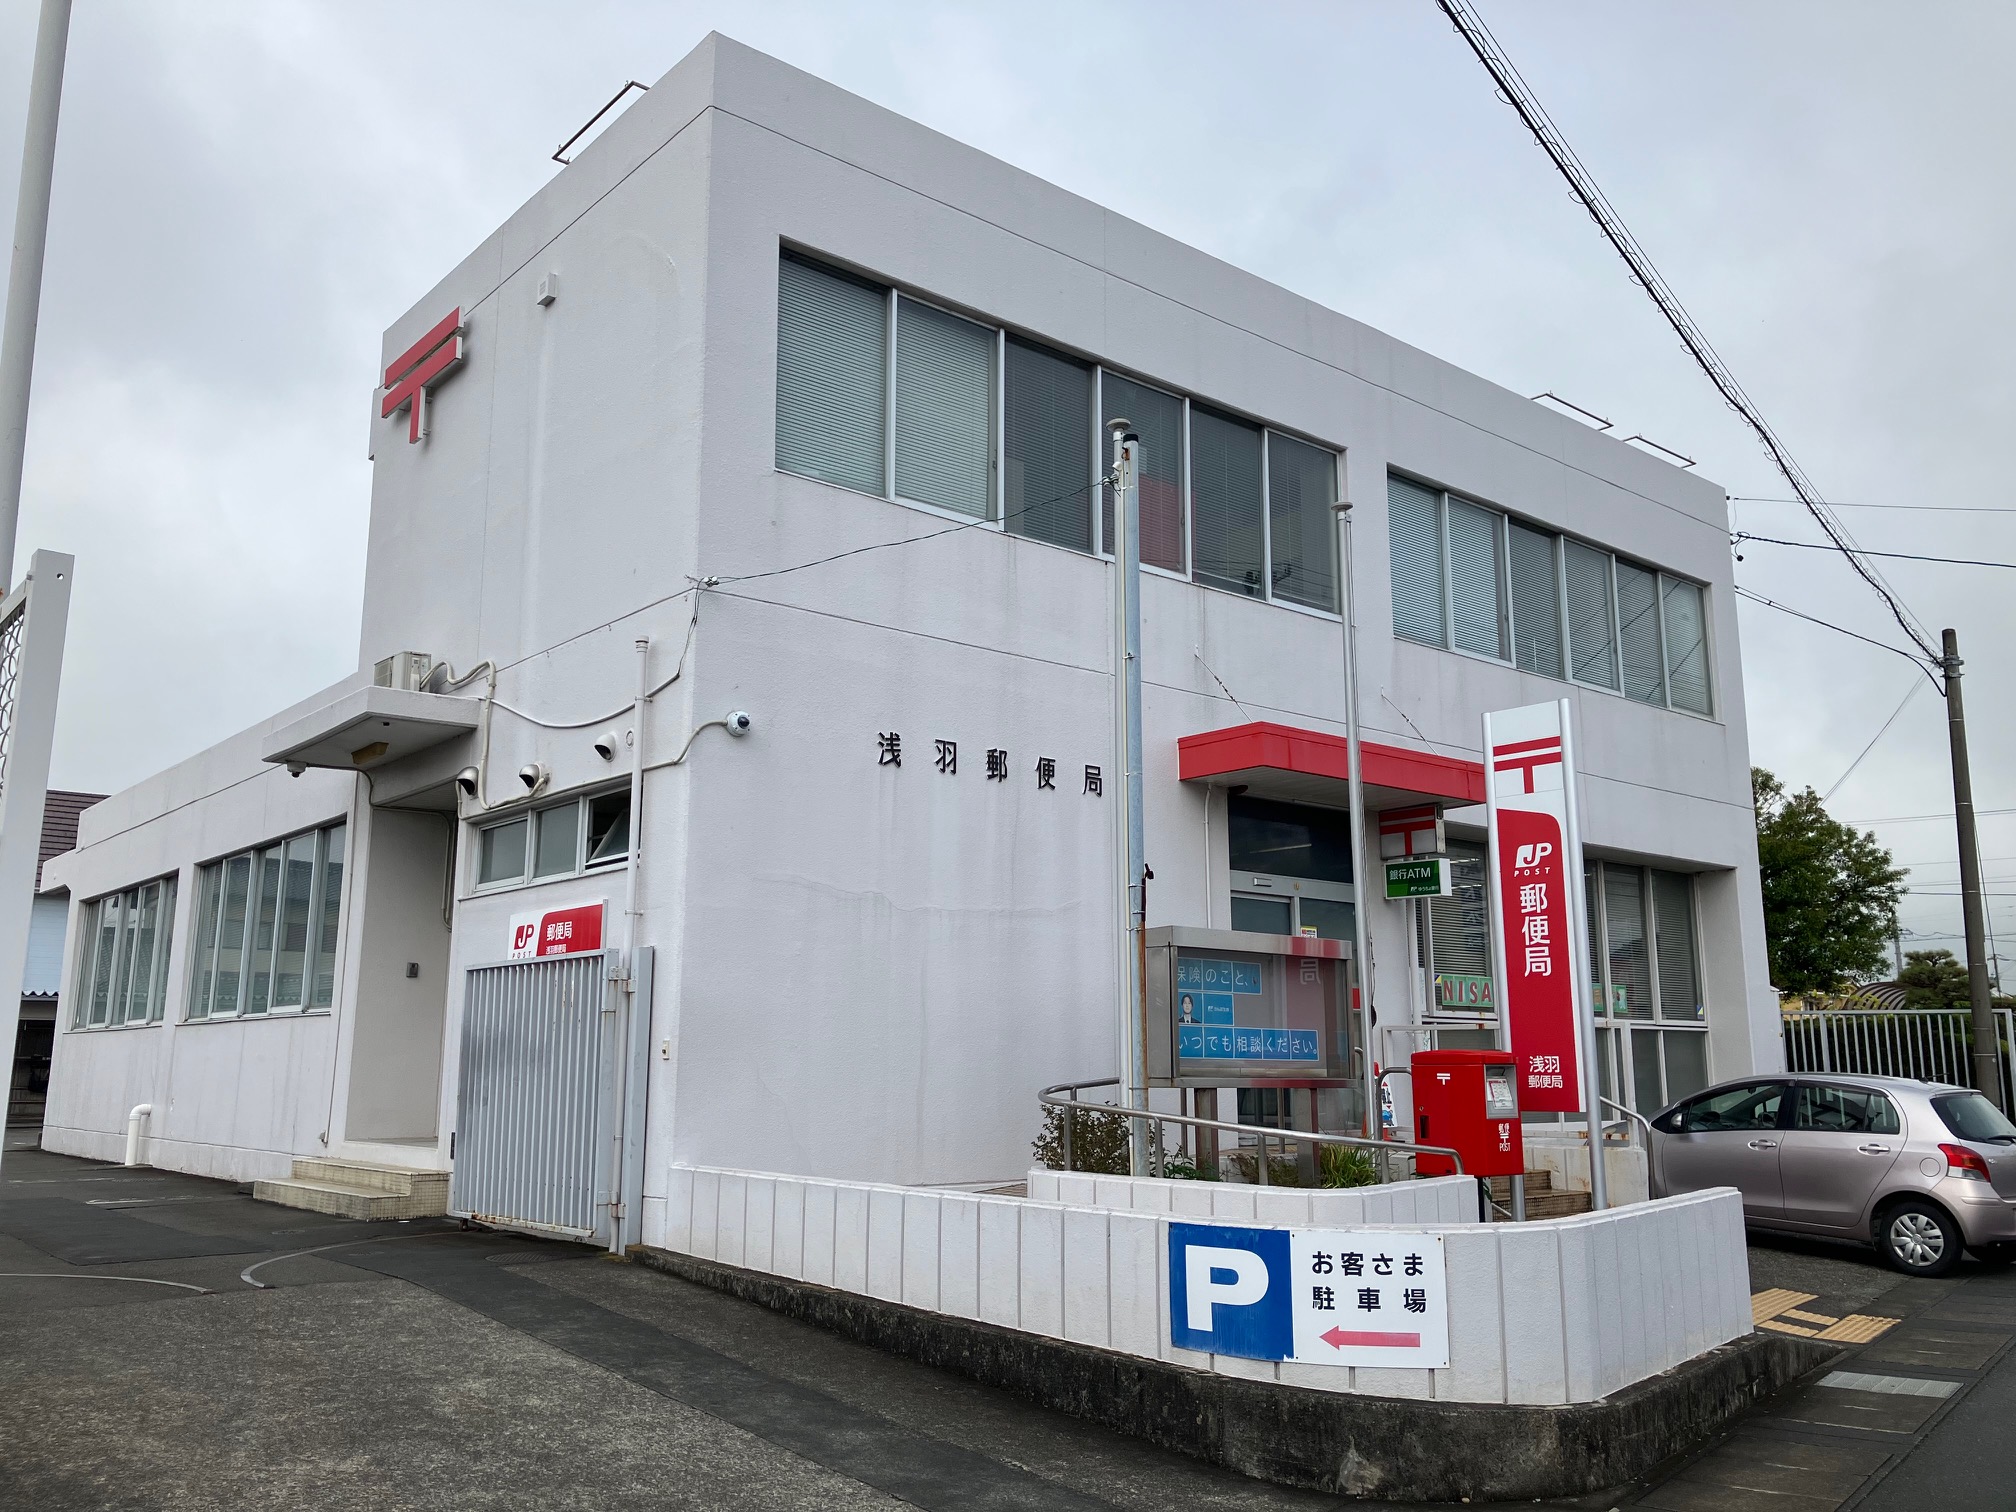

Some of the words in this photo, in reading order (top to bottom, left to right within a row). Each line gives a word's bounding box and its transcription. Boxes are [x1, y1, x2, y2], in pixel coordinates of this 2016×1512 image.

[877, 731, 1103, 798] 浅羽郵便局
[1515, 842, 1552, 868] JP
[1389, 867, 1431, 881] 銀行ATM
[1514, 867, 1551, 877] POST
[514, 924, 535, 950] JP
[547, 921, 572, 941] 郵便局
[1520, 883, 1552, 977] 郵便局
[512, 951, 532, 959] POST
[1443, 980, 1492, 1004] NISA
[1529, 1055, 1560, 1073] 浅羽
[1528, 1074, 1563, 1089] 郵便局
[1499, 1142, 1511, 1152] POST
[1311, 1250, 1424, 1277] お客さま
[1185, 1244, 1269, 1332] P
[1311, 1286, 1427, 1314] 駐車場
